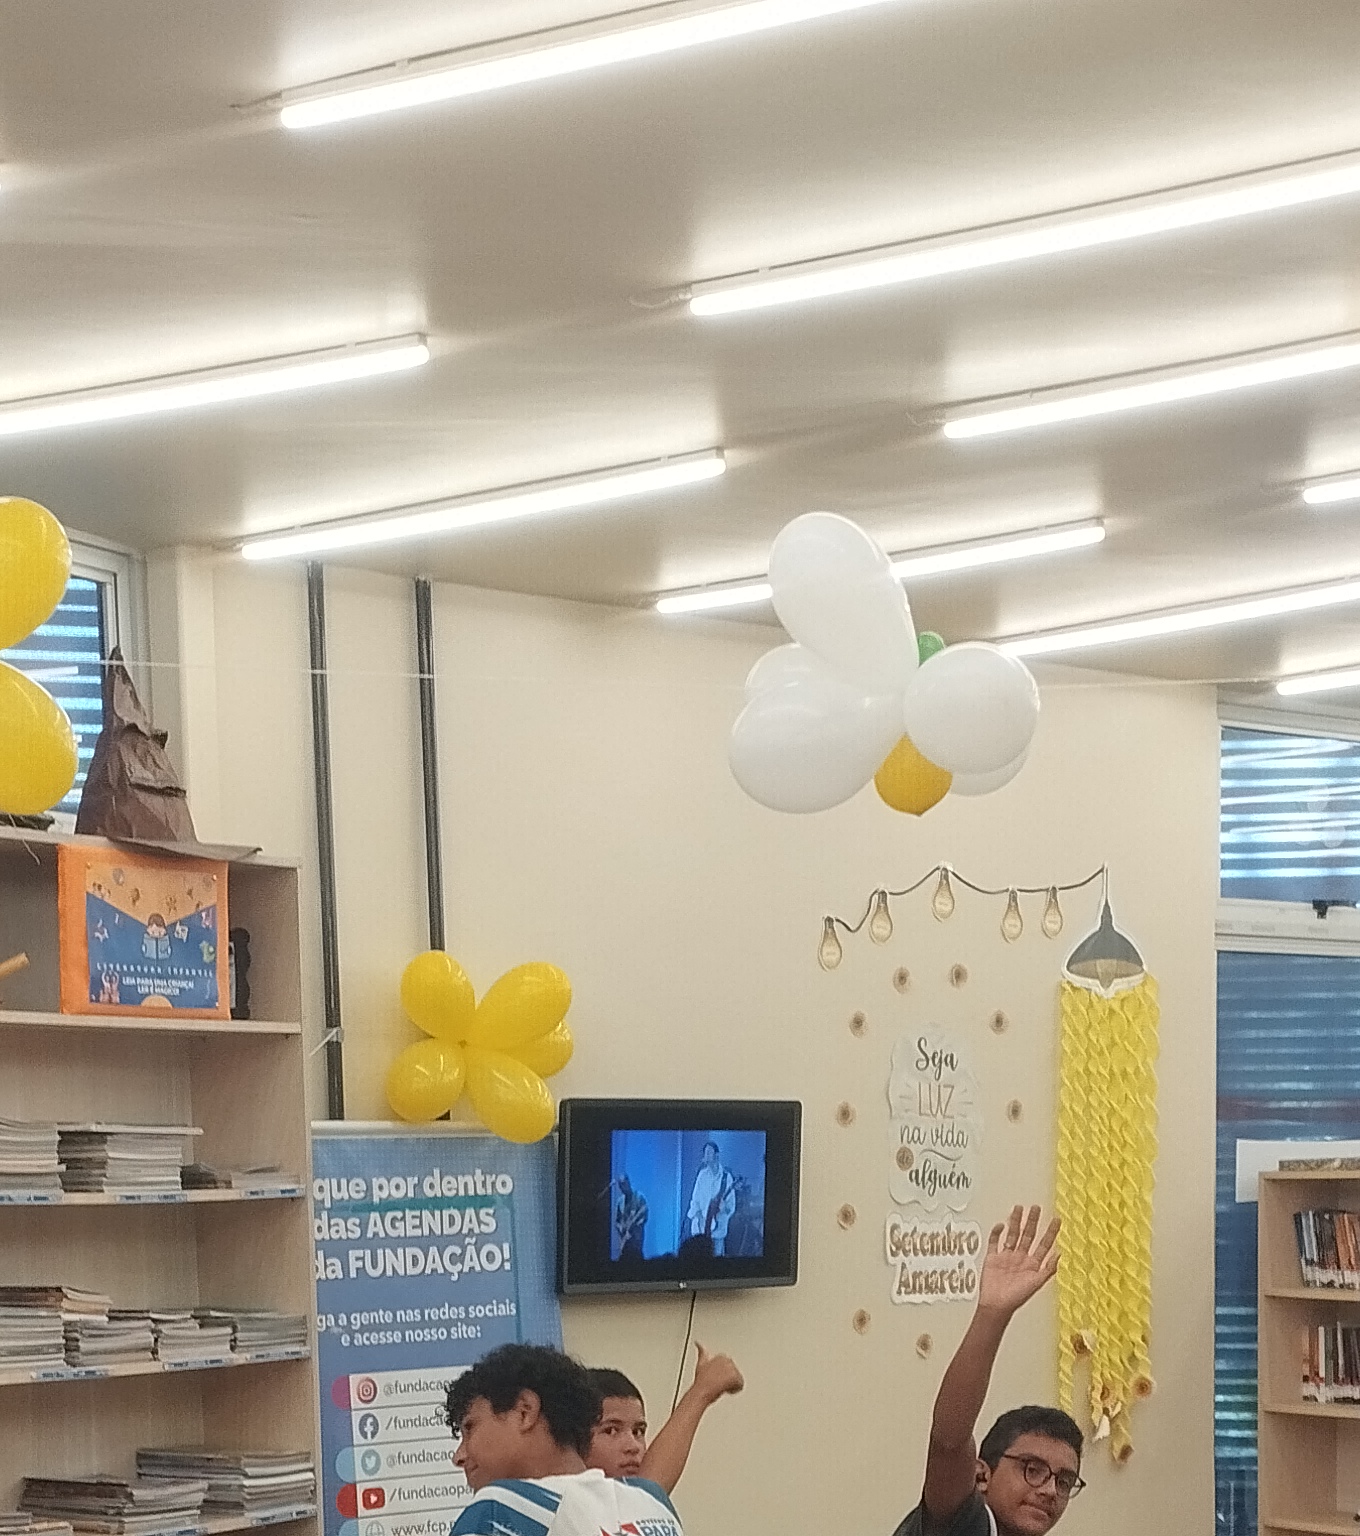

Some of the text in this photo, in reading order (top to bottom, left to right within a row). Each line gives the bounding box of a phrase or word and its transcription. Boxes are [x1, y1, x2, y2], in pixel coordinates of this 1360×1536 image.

[915, 1037, 959, 1082] Seja
[918, 1081, 955, 1119] LUZ
[900, 1121, 969, 1149] na vida
[312, 1167, 514, 1208] que por dentro
[908, 1158, 972, 1197] alguém
[314, 1208, 497, 1241] das AGENDAS
[889, 1222, 979, 1258] Setembro
[348, 1237, 512, 1281] FUNDAÇÃO!
[896, 1260, 976, 1296] Amarelo
[338, 1315, 348, 1327] a
[350, 1308, 393, 1330] gente
[396, 1308, 421, 1324] nas
[424, 1302, 466, 1321] redes
[468, 1298, 517, 1318] sociais
[341, 1321, 482, 1347] e acesse nosso site:
[383, 1376, 453, 1396] @fundacao
